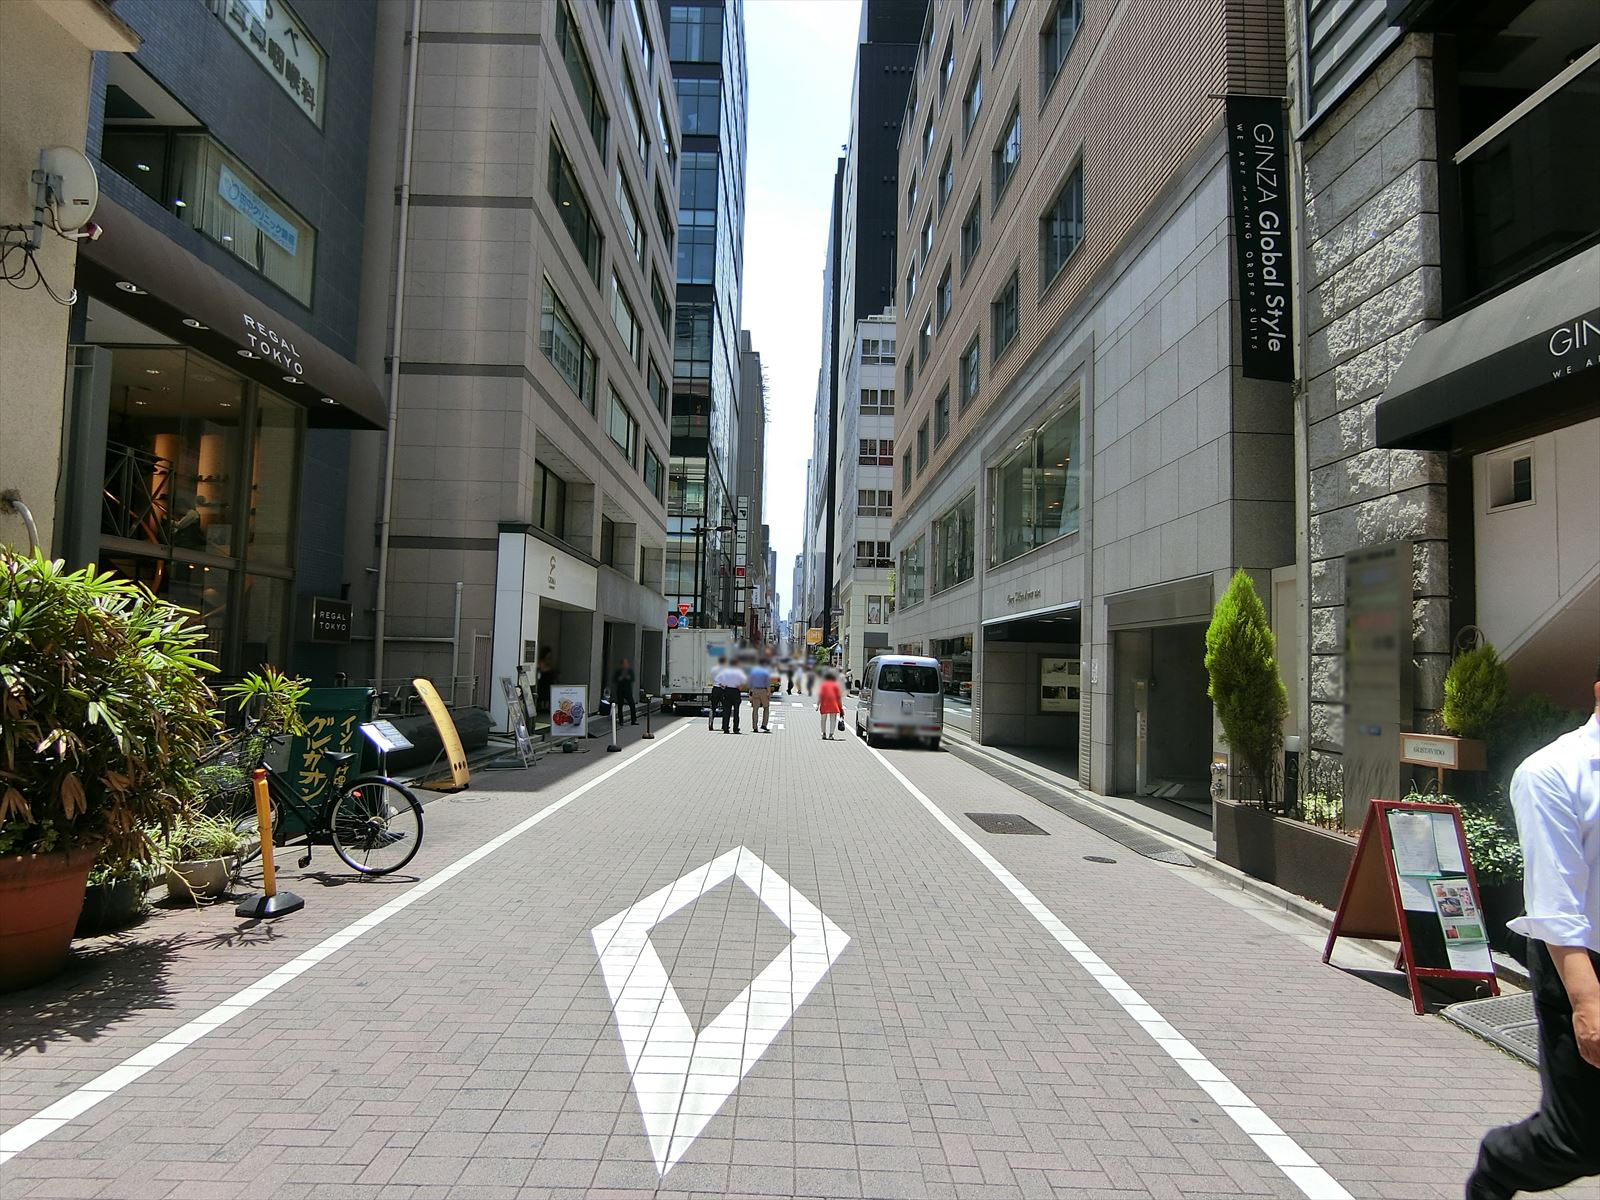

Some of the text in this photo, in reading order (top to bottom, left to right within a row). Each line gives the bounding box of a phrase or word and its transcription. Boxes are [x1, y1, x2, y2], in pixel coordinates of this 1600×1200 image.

[1236, 123, 1244, 140] WE
[1249, 307, 1258, 350] SUITS
[1253, 122, 1287, 352] GINZA Global Style
[243, 313, 301, 358] REGAL
[247, 333, 303, 375] TOKYO
[1552, 354, 1600, 379] WE A
[319, 611, 346, 621] REGAL
[319, 621, 347, 631] TOKYO
[297, 715, 335, 801] グルガオン
